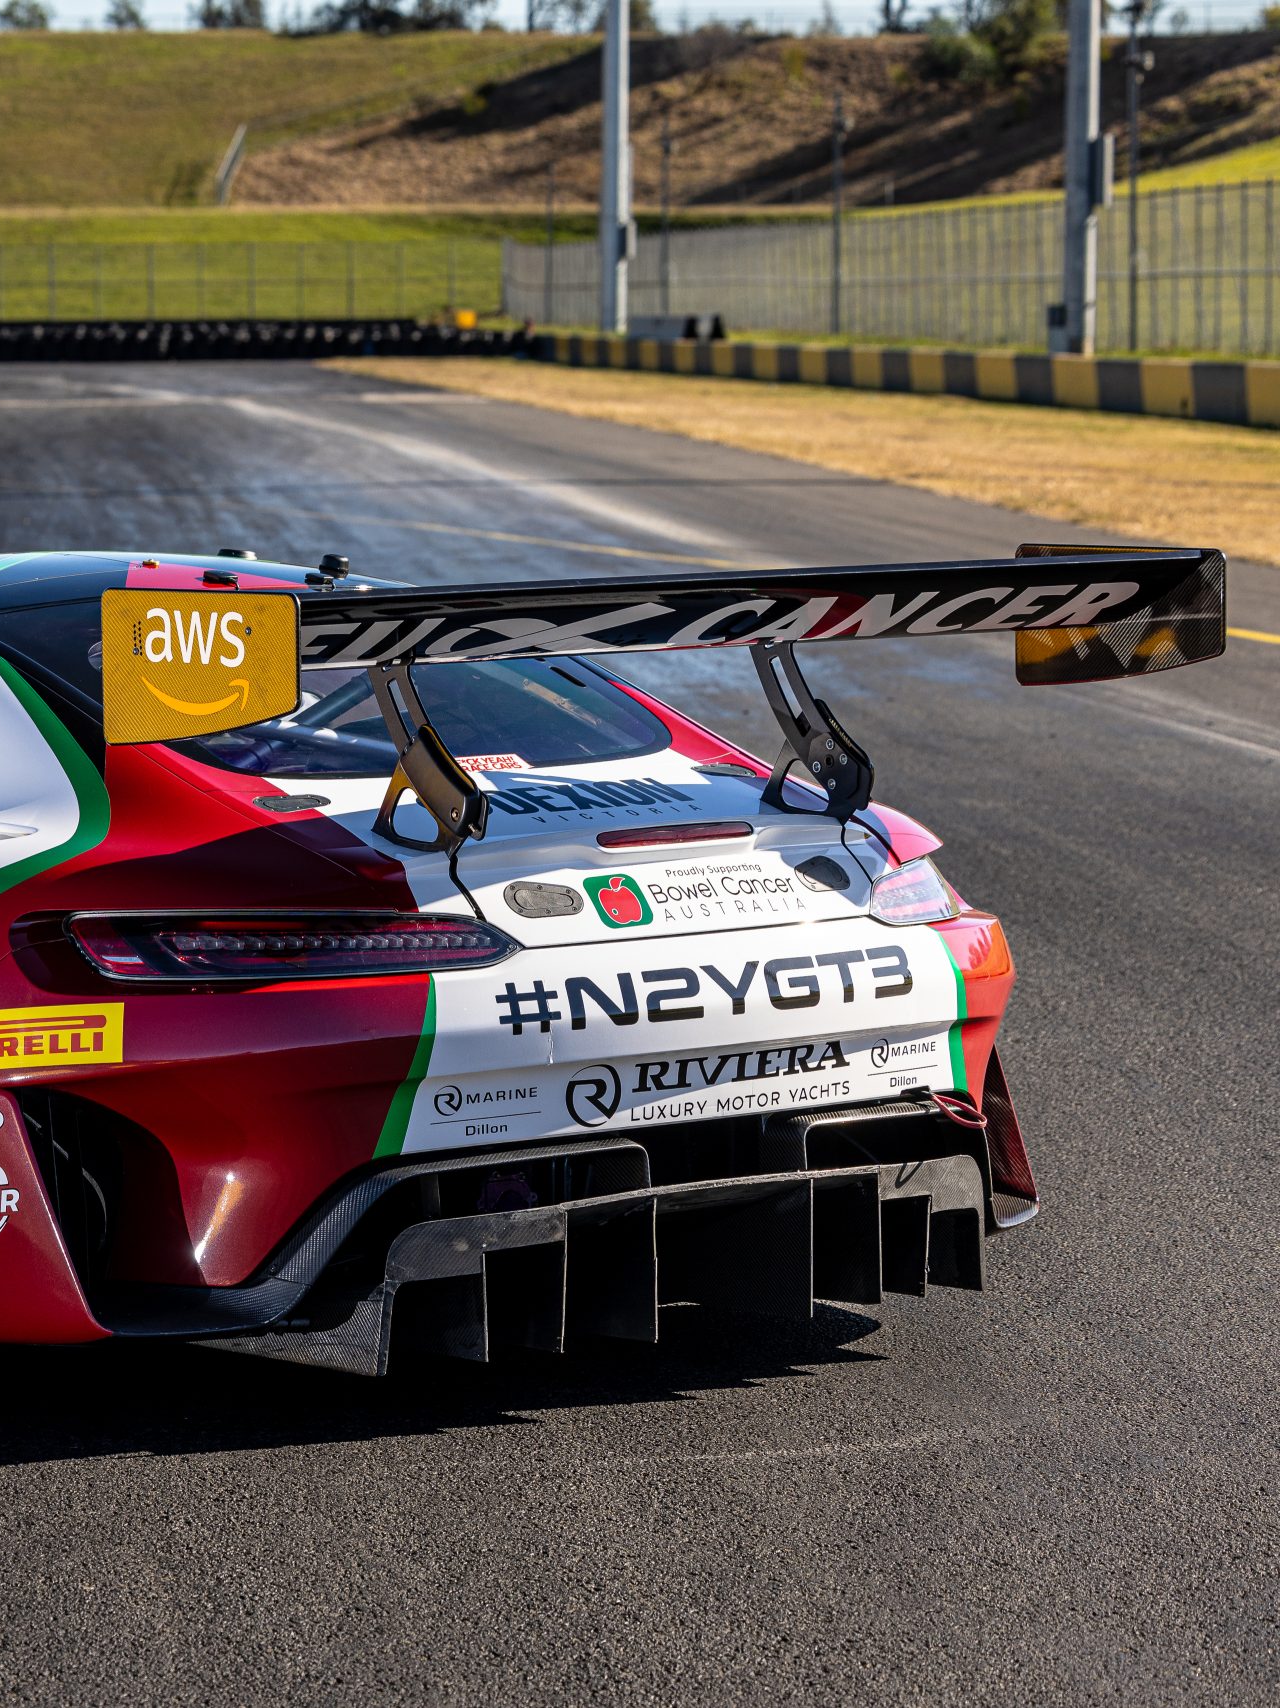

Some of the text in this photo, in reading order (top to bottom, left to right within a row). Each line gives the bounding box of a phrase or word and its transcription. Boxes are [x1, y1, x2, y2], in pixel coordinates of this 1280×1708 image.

[667, 581, 1140, 645] CANCER
[145, 608, 245, 668] aws
[480, 756, 514, 764] YEAH!
[490, 777, 694, 815] DEXION
[532, 804, 702, 824] VICTORIA
[665, 863, 762, 878] Proudly Supporting
[648, 876, 795, 904] Bowel Cancer
[664, 897, 807, 922] AUSTRALIA
[495, 945, 913, 1035] #N2YGT3
[891, 1041, 936, 1057] MARINE
[632, 1040, 850, 1094] RIVIERA
[889, 1075, 918, 1088] Dillon
[466, 1086, 538, 1105] MARINE
[631, 1080, 850, 1122] LUXURY MOTOR YACHTS
[465, 1123, 508, 1136] Dillon
